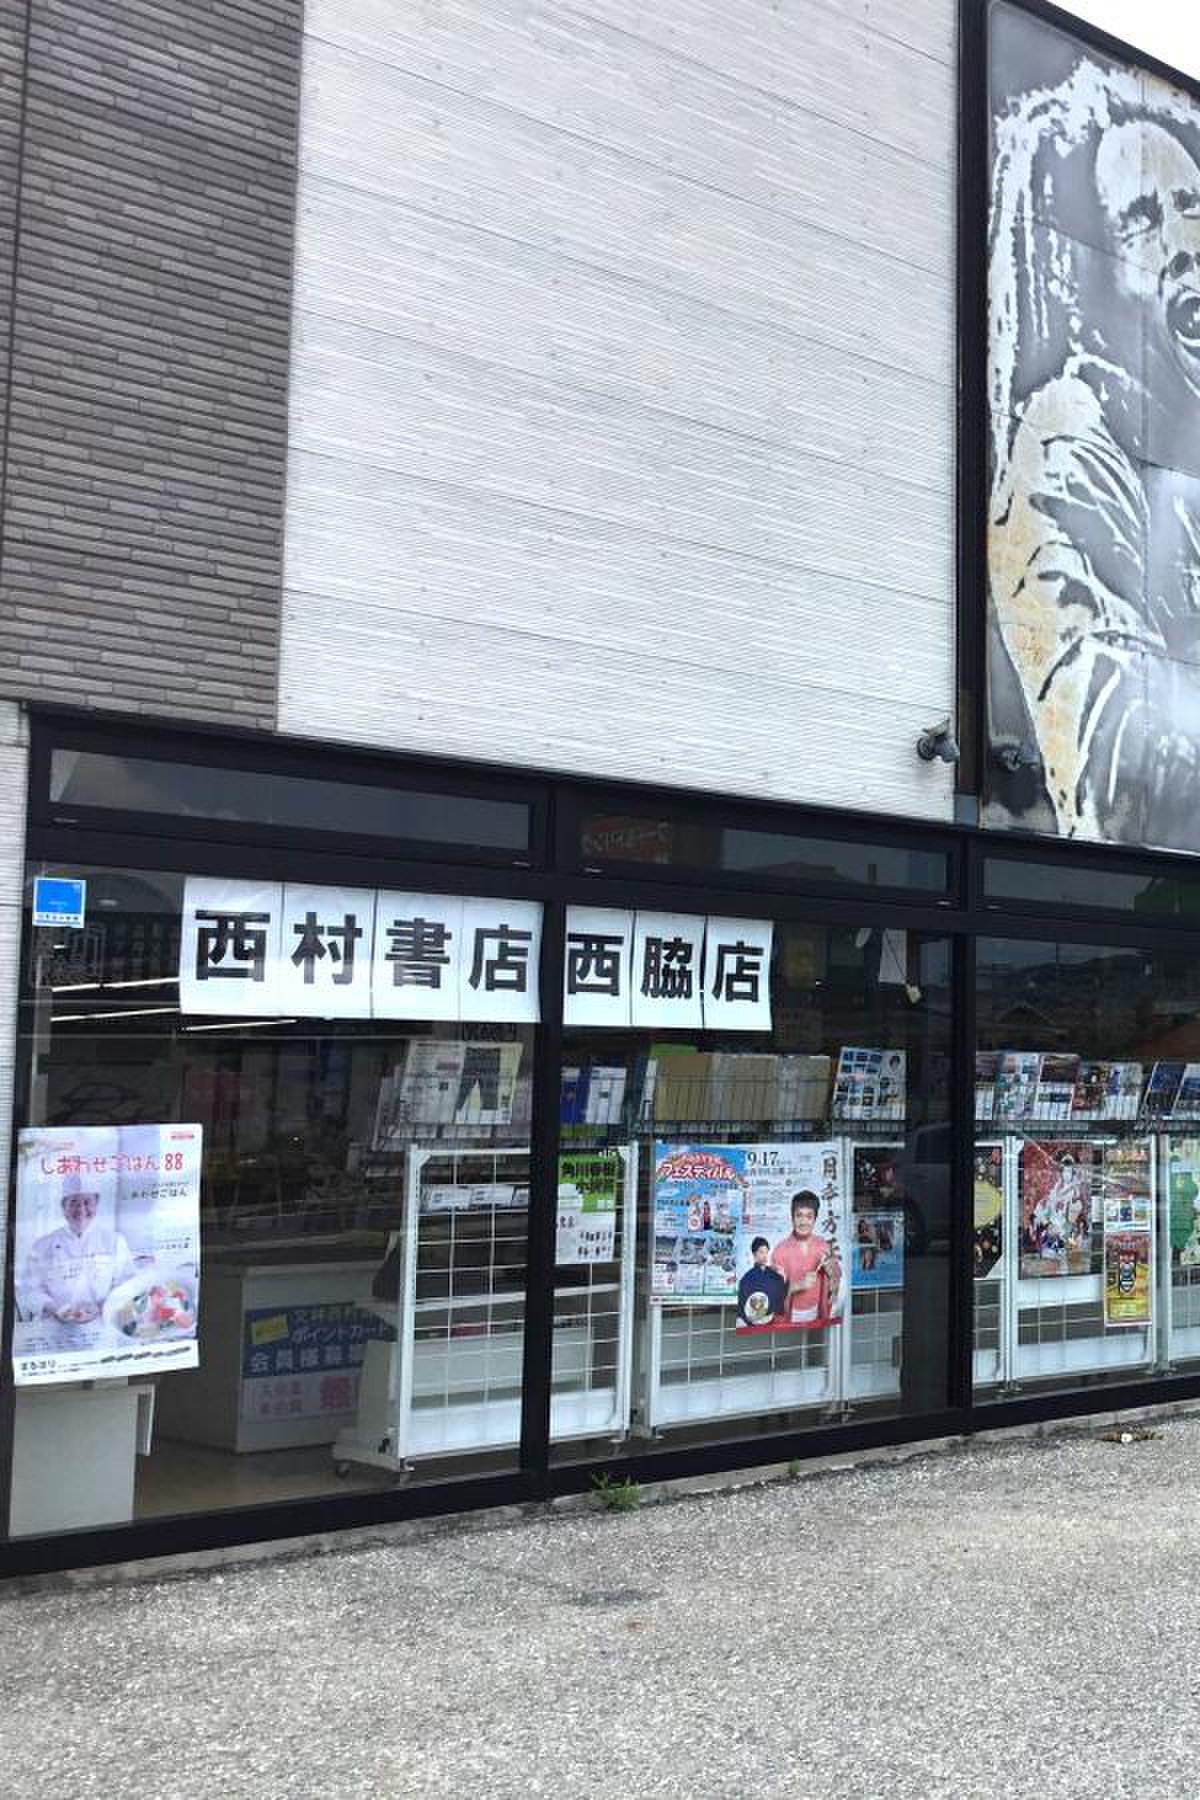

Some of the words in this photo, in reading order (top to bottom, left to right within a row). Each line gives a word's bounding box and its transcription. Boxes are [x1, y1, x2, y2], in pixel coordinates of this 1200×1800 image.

[195, 909, 533, 993] 西村書店
[567, 933, 765, 1003] 西脇店
[41, 1152, 159, 1175] しあわせごはん
[164, 1152, 184, 1172] 88
[656, 1162, 738, 1181] フェスティバル
